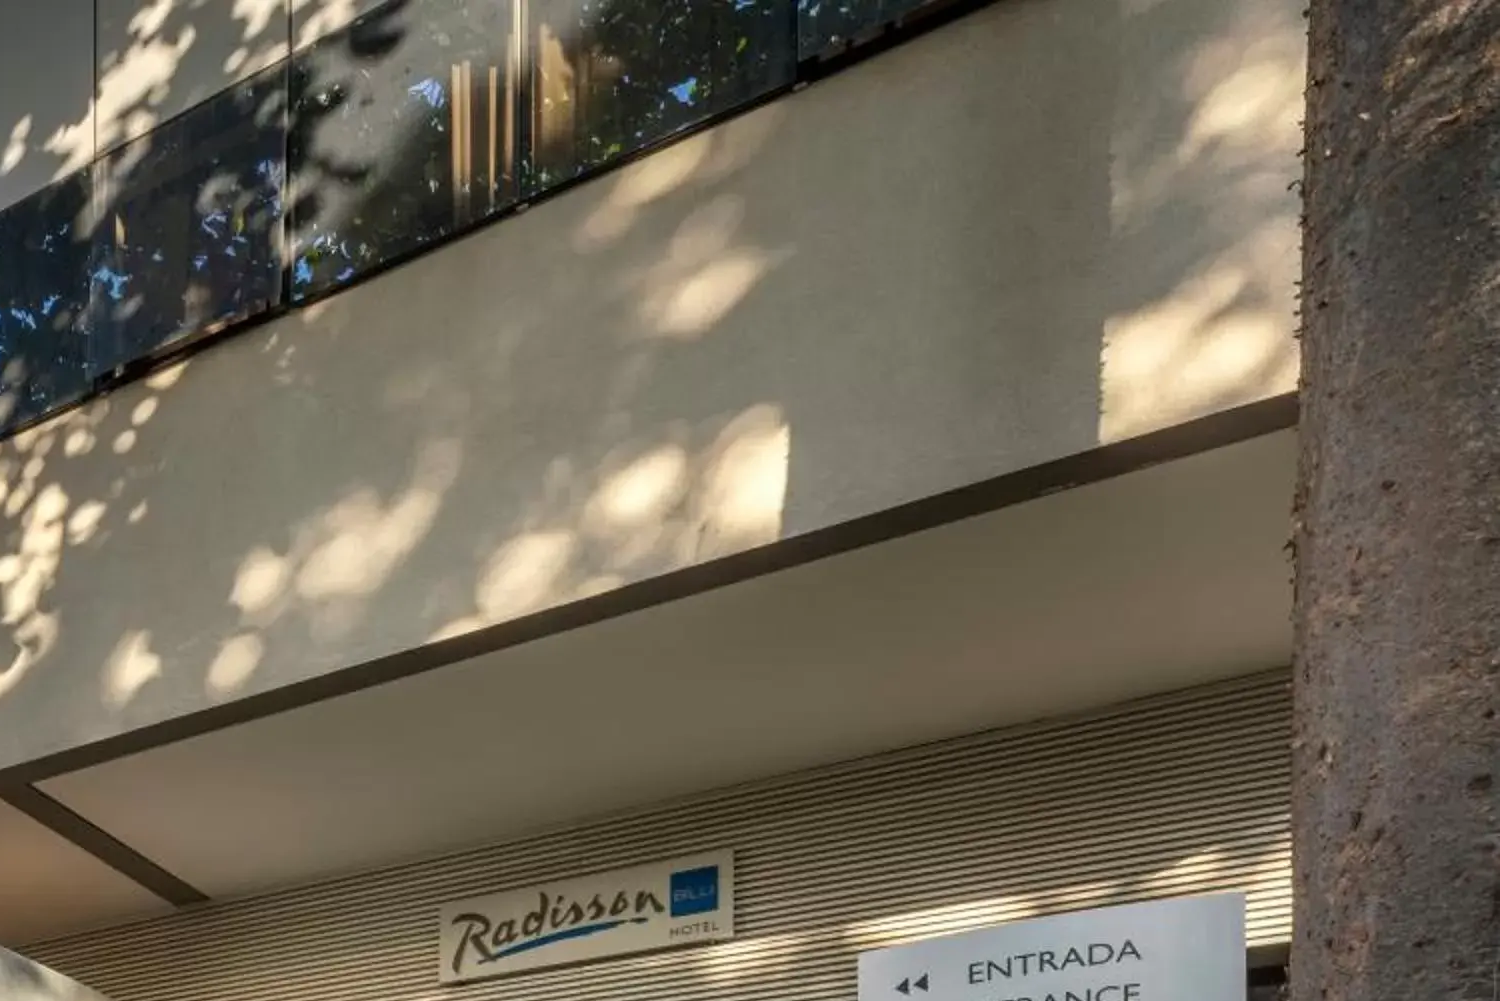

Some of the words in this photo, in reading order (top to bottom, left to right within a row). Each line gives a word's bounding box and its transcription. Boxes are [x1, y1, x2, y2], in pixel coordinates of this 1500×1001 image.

[452, 891, 664, 974] Radisson
[669, 921, 720, 938] HOTEL
[968, 939, 1142, 985] ENTRADA
